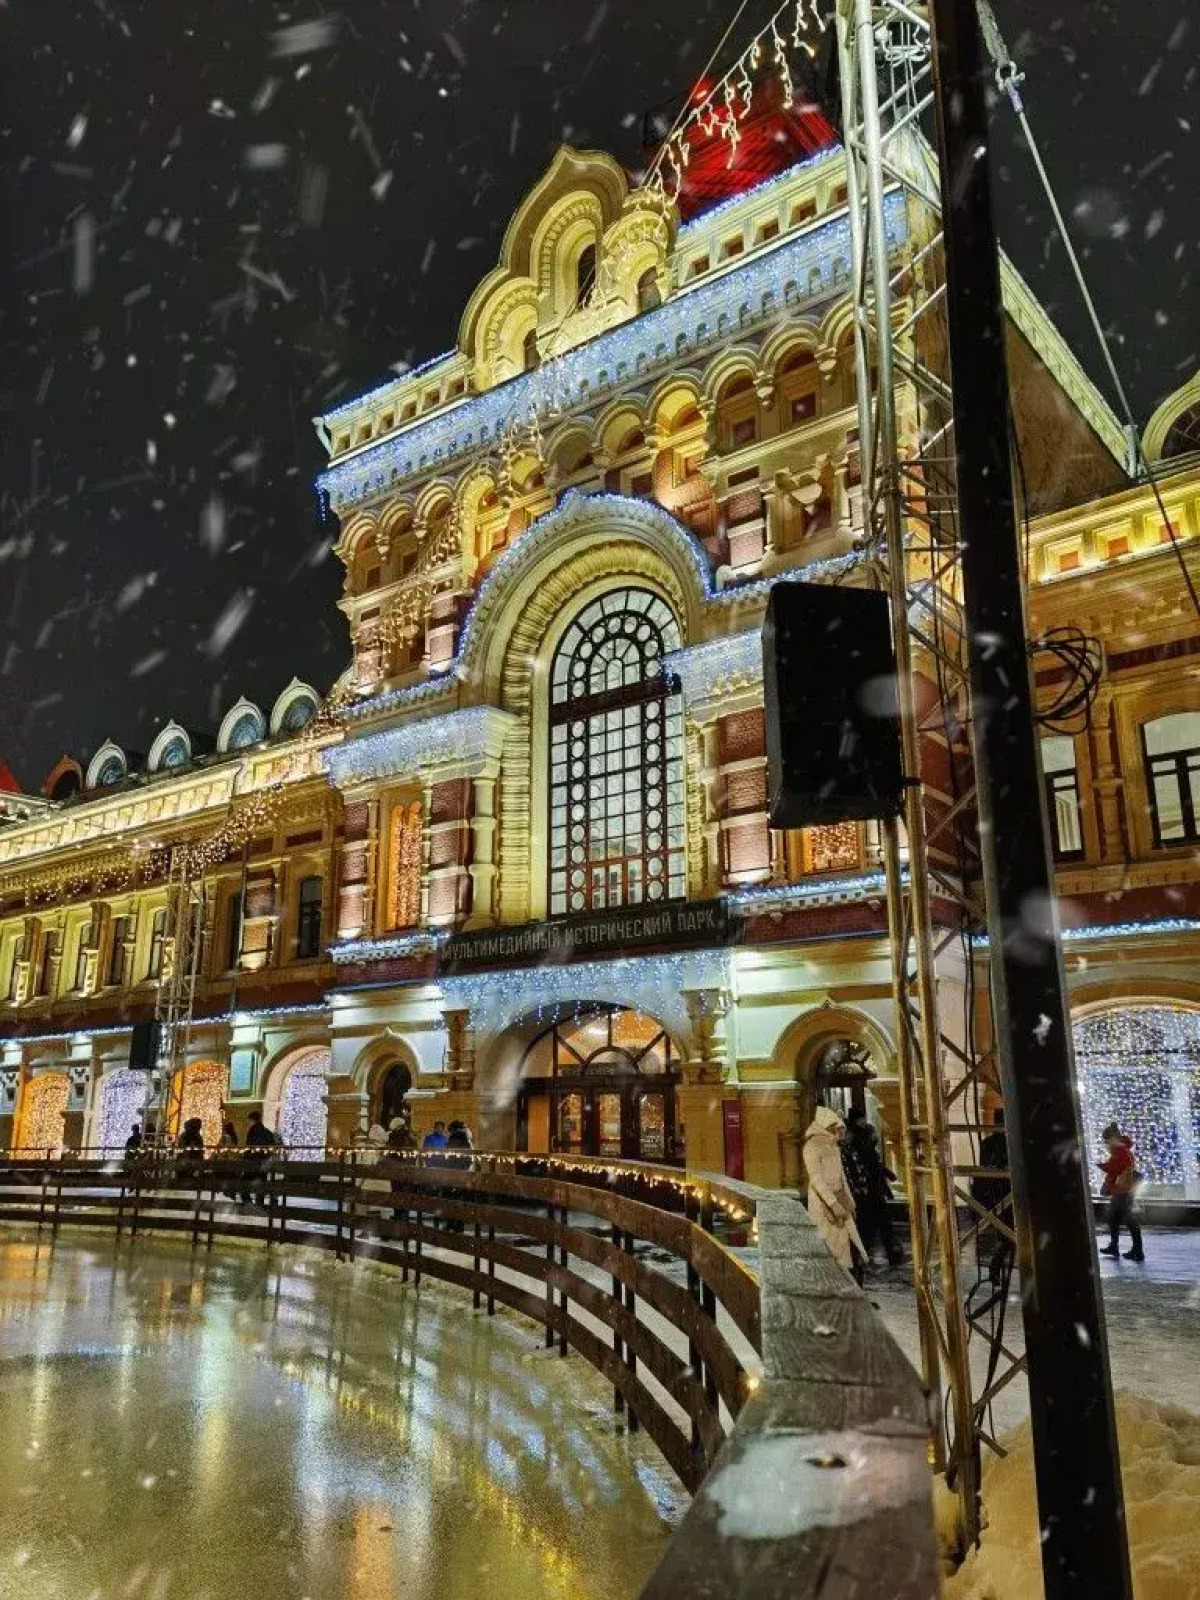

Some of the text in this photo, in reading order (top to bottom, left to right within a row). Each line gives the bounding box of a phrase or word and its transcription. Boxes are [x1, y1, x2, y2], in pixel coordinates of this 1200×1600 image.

[441, 908, 715, 959] МУЛЬТИМЕДИЙНЫЙ ИСТОРИЧЕСКИЙ ПАРК
